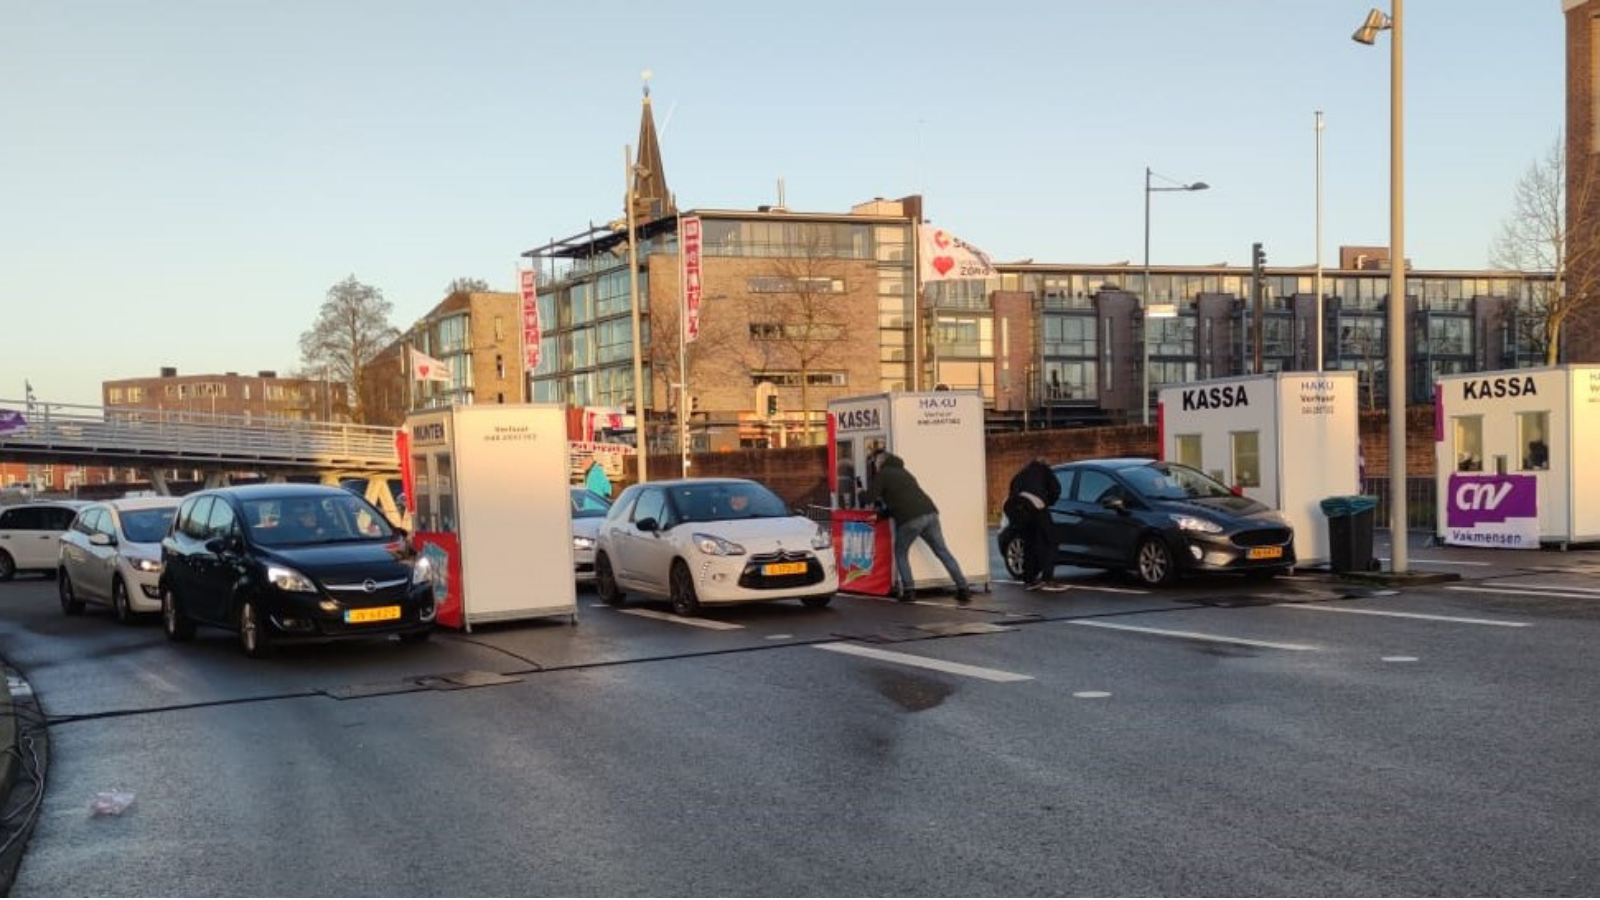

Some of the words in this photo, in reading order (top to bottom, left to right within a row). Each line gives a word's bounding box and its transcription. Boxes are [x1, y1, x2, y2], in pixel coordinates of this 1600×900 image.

[1301, 381, 1334, 391] HAKU
[1463, 376, 1537, 400] KASSA
[1183, 385, 1249, 411] KASSA
[838, 408, 880, 429] KASSA
[1452, 529, 1521, 544] Vakmensen
